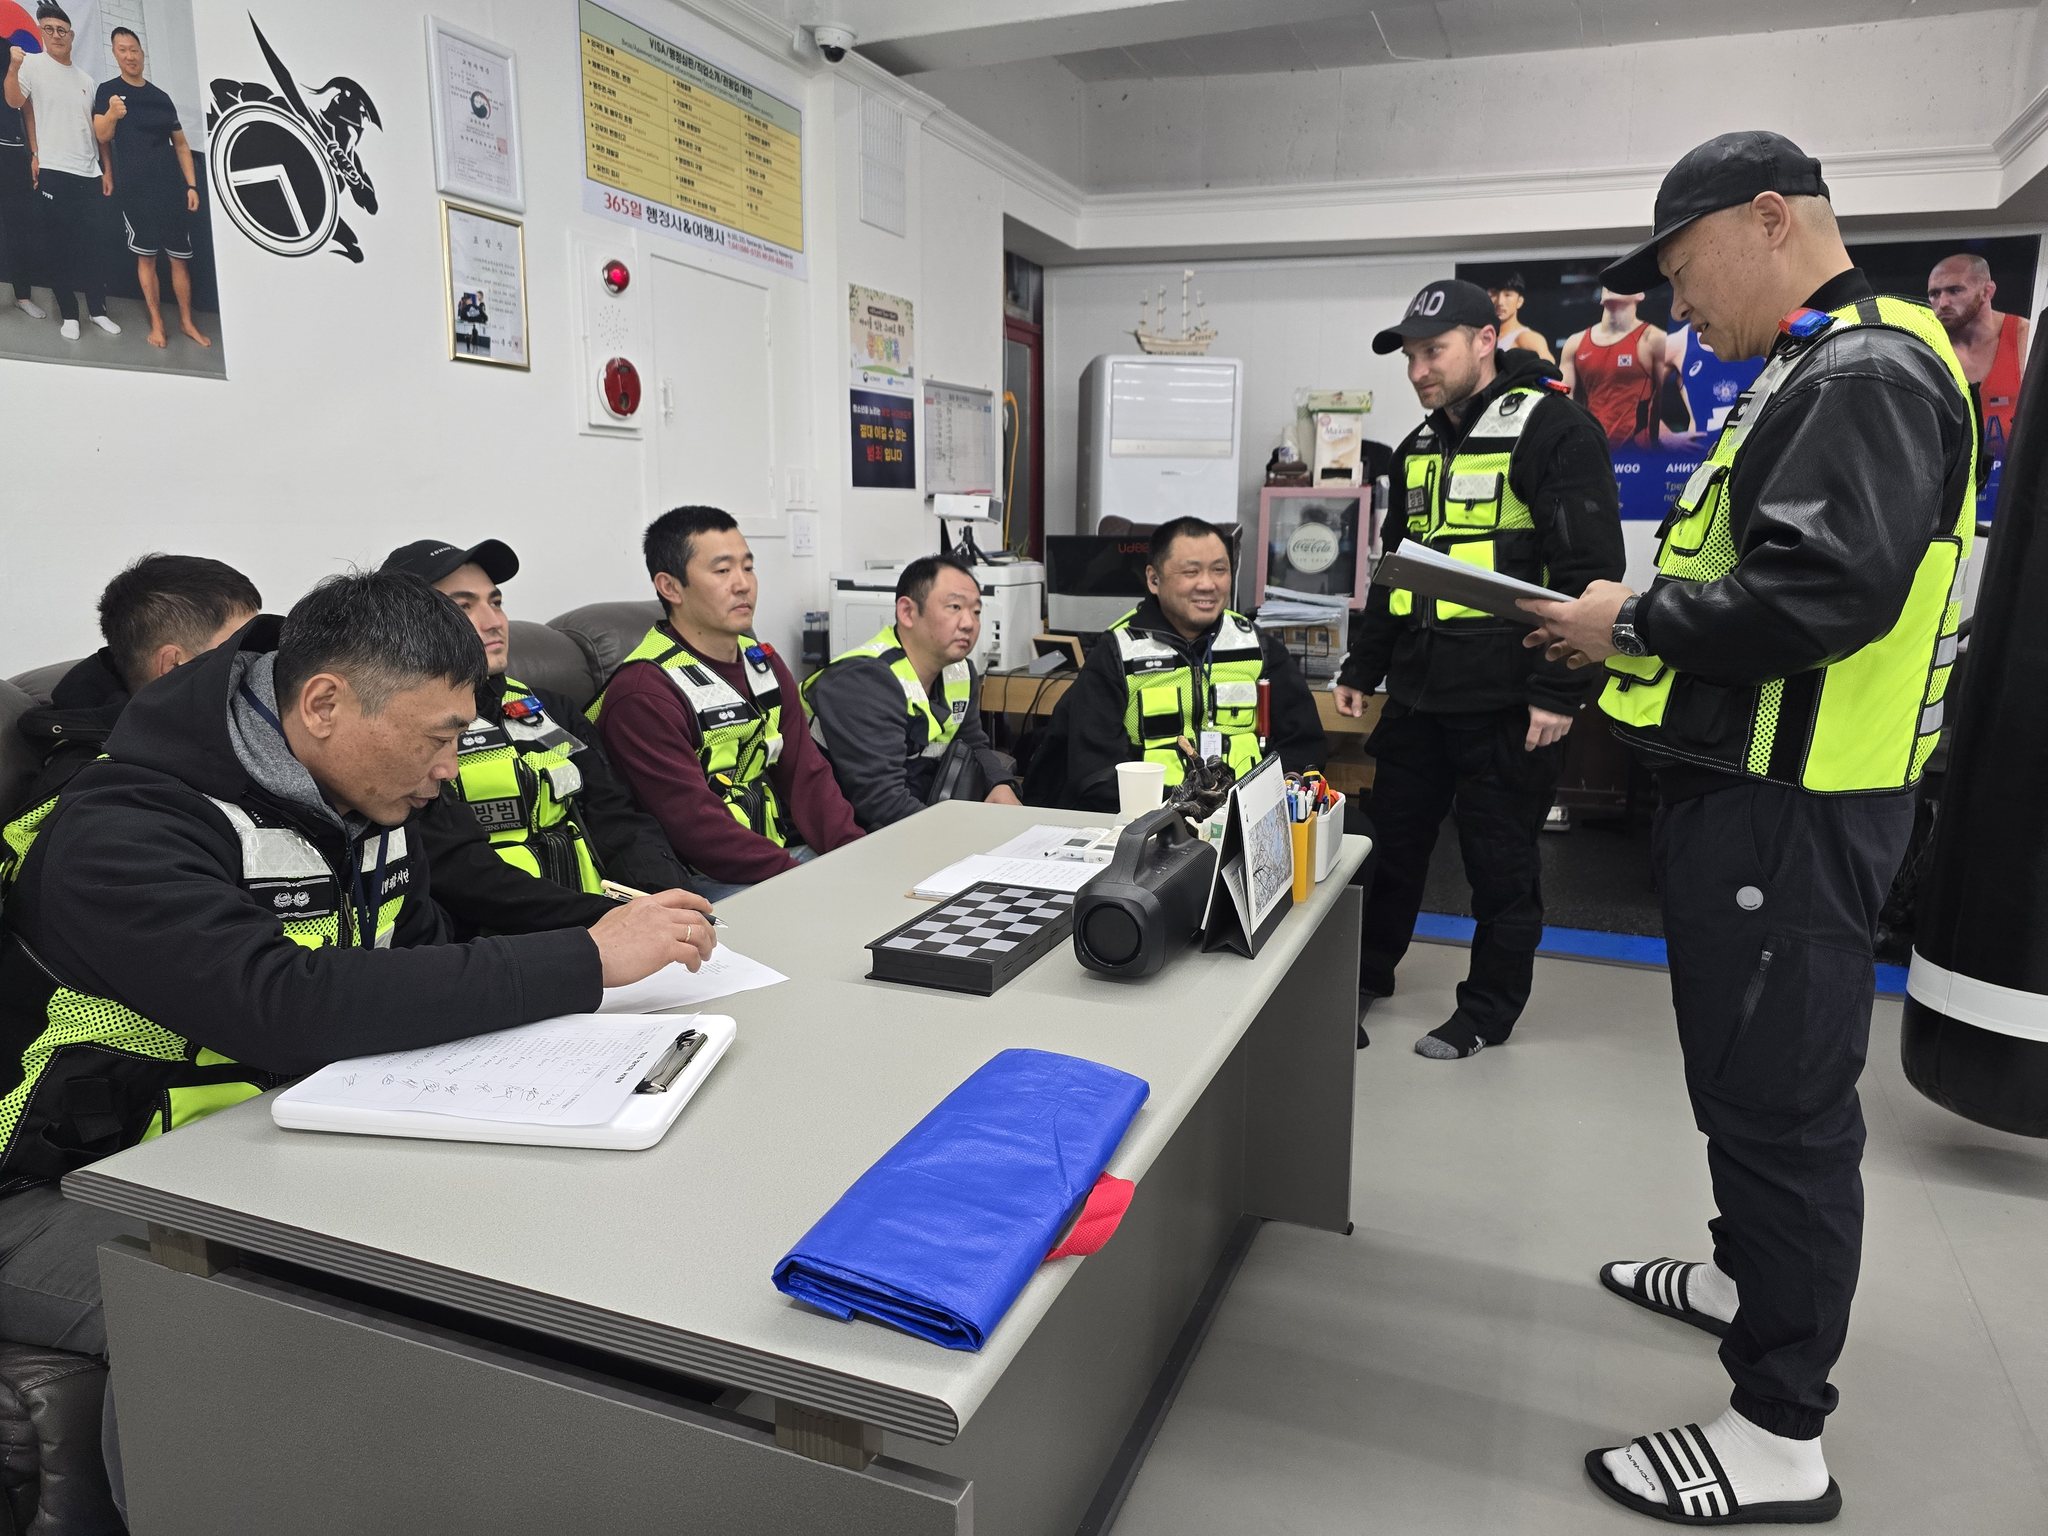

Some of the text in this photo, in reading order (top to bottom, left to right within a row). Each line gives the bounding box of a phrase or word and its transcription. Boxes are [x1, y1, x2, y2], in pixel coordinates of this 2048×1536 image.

[603, 191, 643, 220] 365일
[646, 204, 725, 247] 행정사&여행사
[860, 424, 907, 442] 절대 이길 수 없는
[884, 447, 903, 463] 입니다
[1665, 463, 1701, 474] АНИУ
[474, 801, 516, 823] 방범
[1626, 1452, 1656, 1491] ARMOUR
